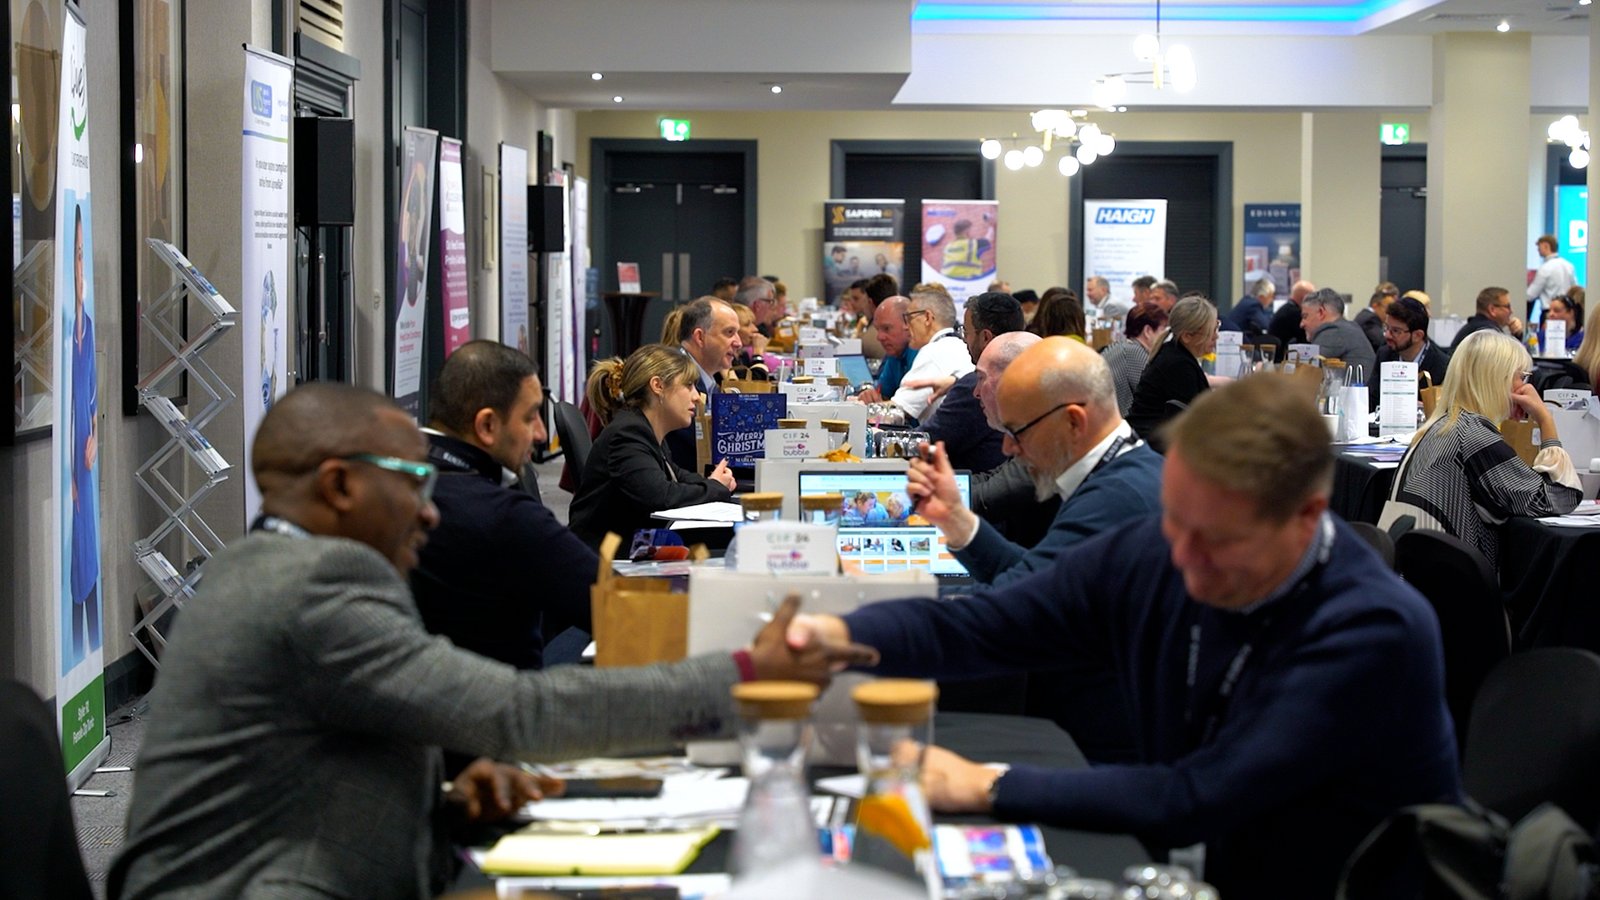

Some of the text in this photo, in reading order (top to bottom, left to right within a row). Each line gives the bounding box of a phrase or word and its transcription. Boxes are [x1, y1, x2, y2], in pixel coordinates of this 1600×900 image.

[1096, 208, 1154, 224] HAIGH
[1250, 209, 1287, 218] EDISON
[734, 431, 764, 442] MERRY
[717, 439, 765, 455] CHRISTM
